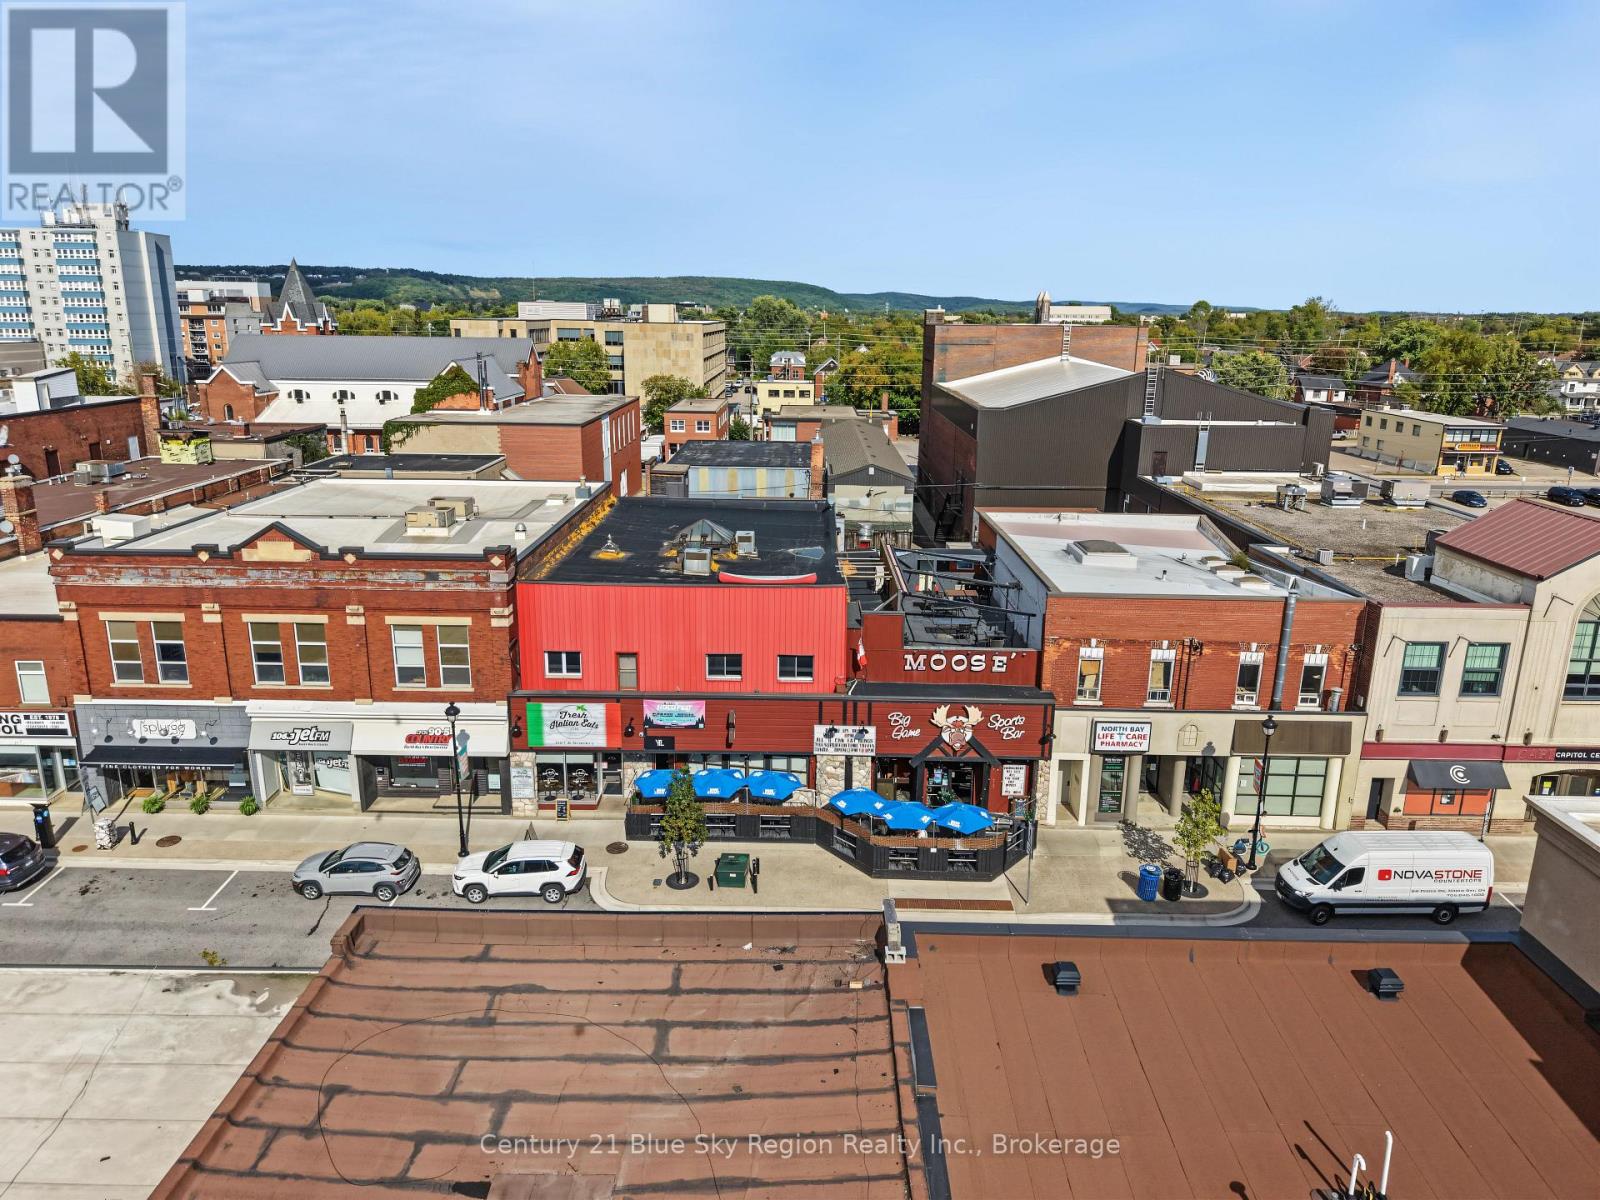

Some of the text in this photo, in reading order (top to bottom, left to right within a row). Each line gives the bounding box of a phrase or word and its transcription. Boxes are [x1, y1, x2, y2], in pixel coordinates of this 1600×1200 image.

[560, 710, 587, 720] Fresh
[888, 712, 911, 726] Big
[988, 714, 1025, 730] Sports
[892, 725, 920, 740] Game
[1001, 726, 1025, 740] Bar
[1393, 870, 1483, 879] NOVASTONE
